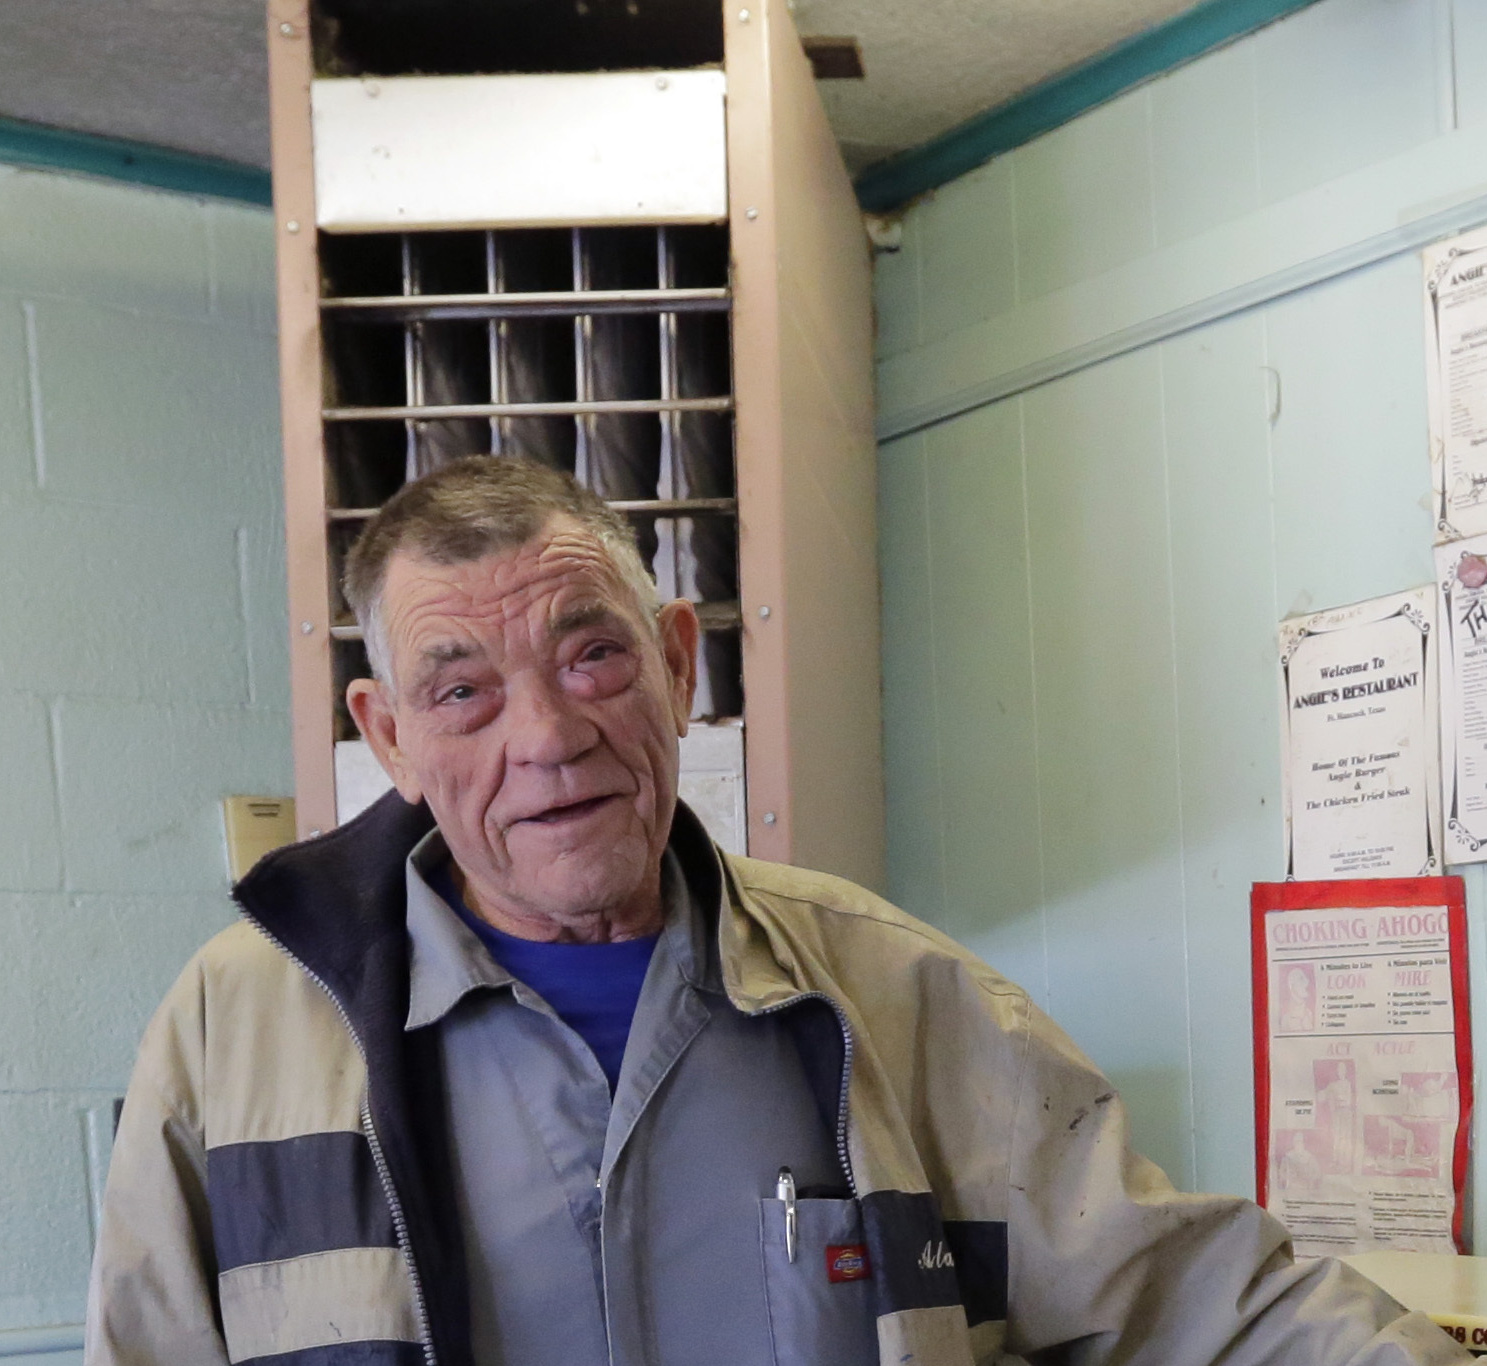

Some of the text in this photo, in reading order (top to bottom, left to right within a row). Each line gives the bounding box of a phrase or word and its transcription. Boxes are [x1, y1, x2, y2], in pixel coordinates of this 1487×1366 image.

[1319, 657, 1386, 680] Welcome To
[1293, 671, 1419, 710] ANGIE'S RESTAURANT
[1312, 761, 1336, 772] Home
[1350, 754, 1366, 766] The
[1368, 750, 1401, 764] Famous
[1327, 765, 1386, 783] Angie Burger
[1306, 786, 1411, 810] The Chicken Fried Steak
[1273, 918, 1368, 944] CHOKING
[1326, 973, 1368, 990] LOOK
[1394, 970, 1433, 987] MIRE
[1326, 1042, 1353, 1056] ACT
